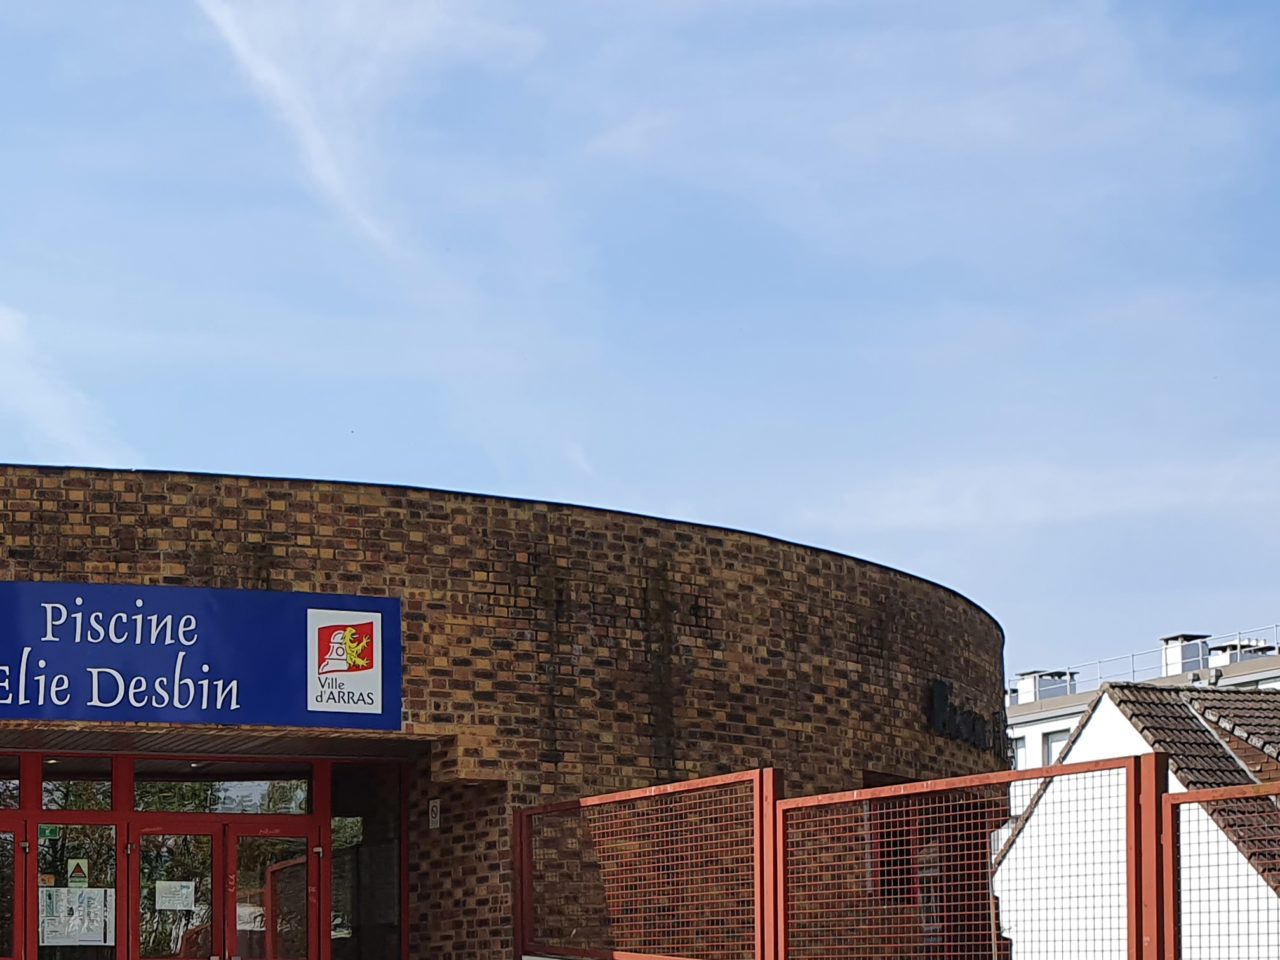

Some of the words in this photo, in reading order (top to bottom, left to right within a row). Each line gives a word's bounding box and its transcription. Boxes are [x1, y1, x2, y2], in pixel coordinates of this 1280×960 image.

[41, 597, 198, 646] Piscine
[86, 651, 241, 710] Desbin
[317, 676, 345, 690] Ville
[315, 690, 375, 705] d'ARRAS
